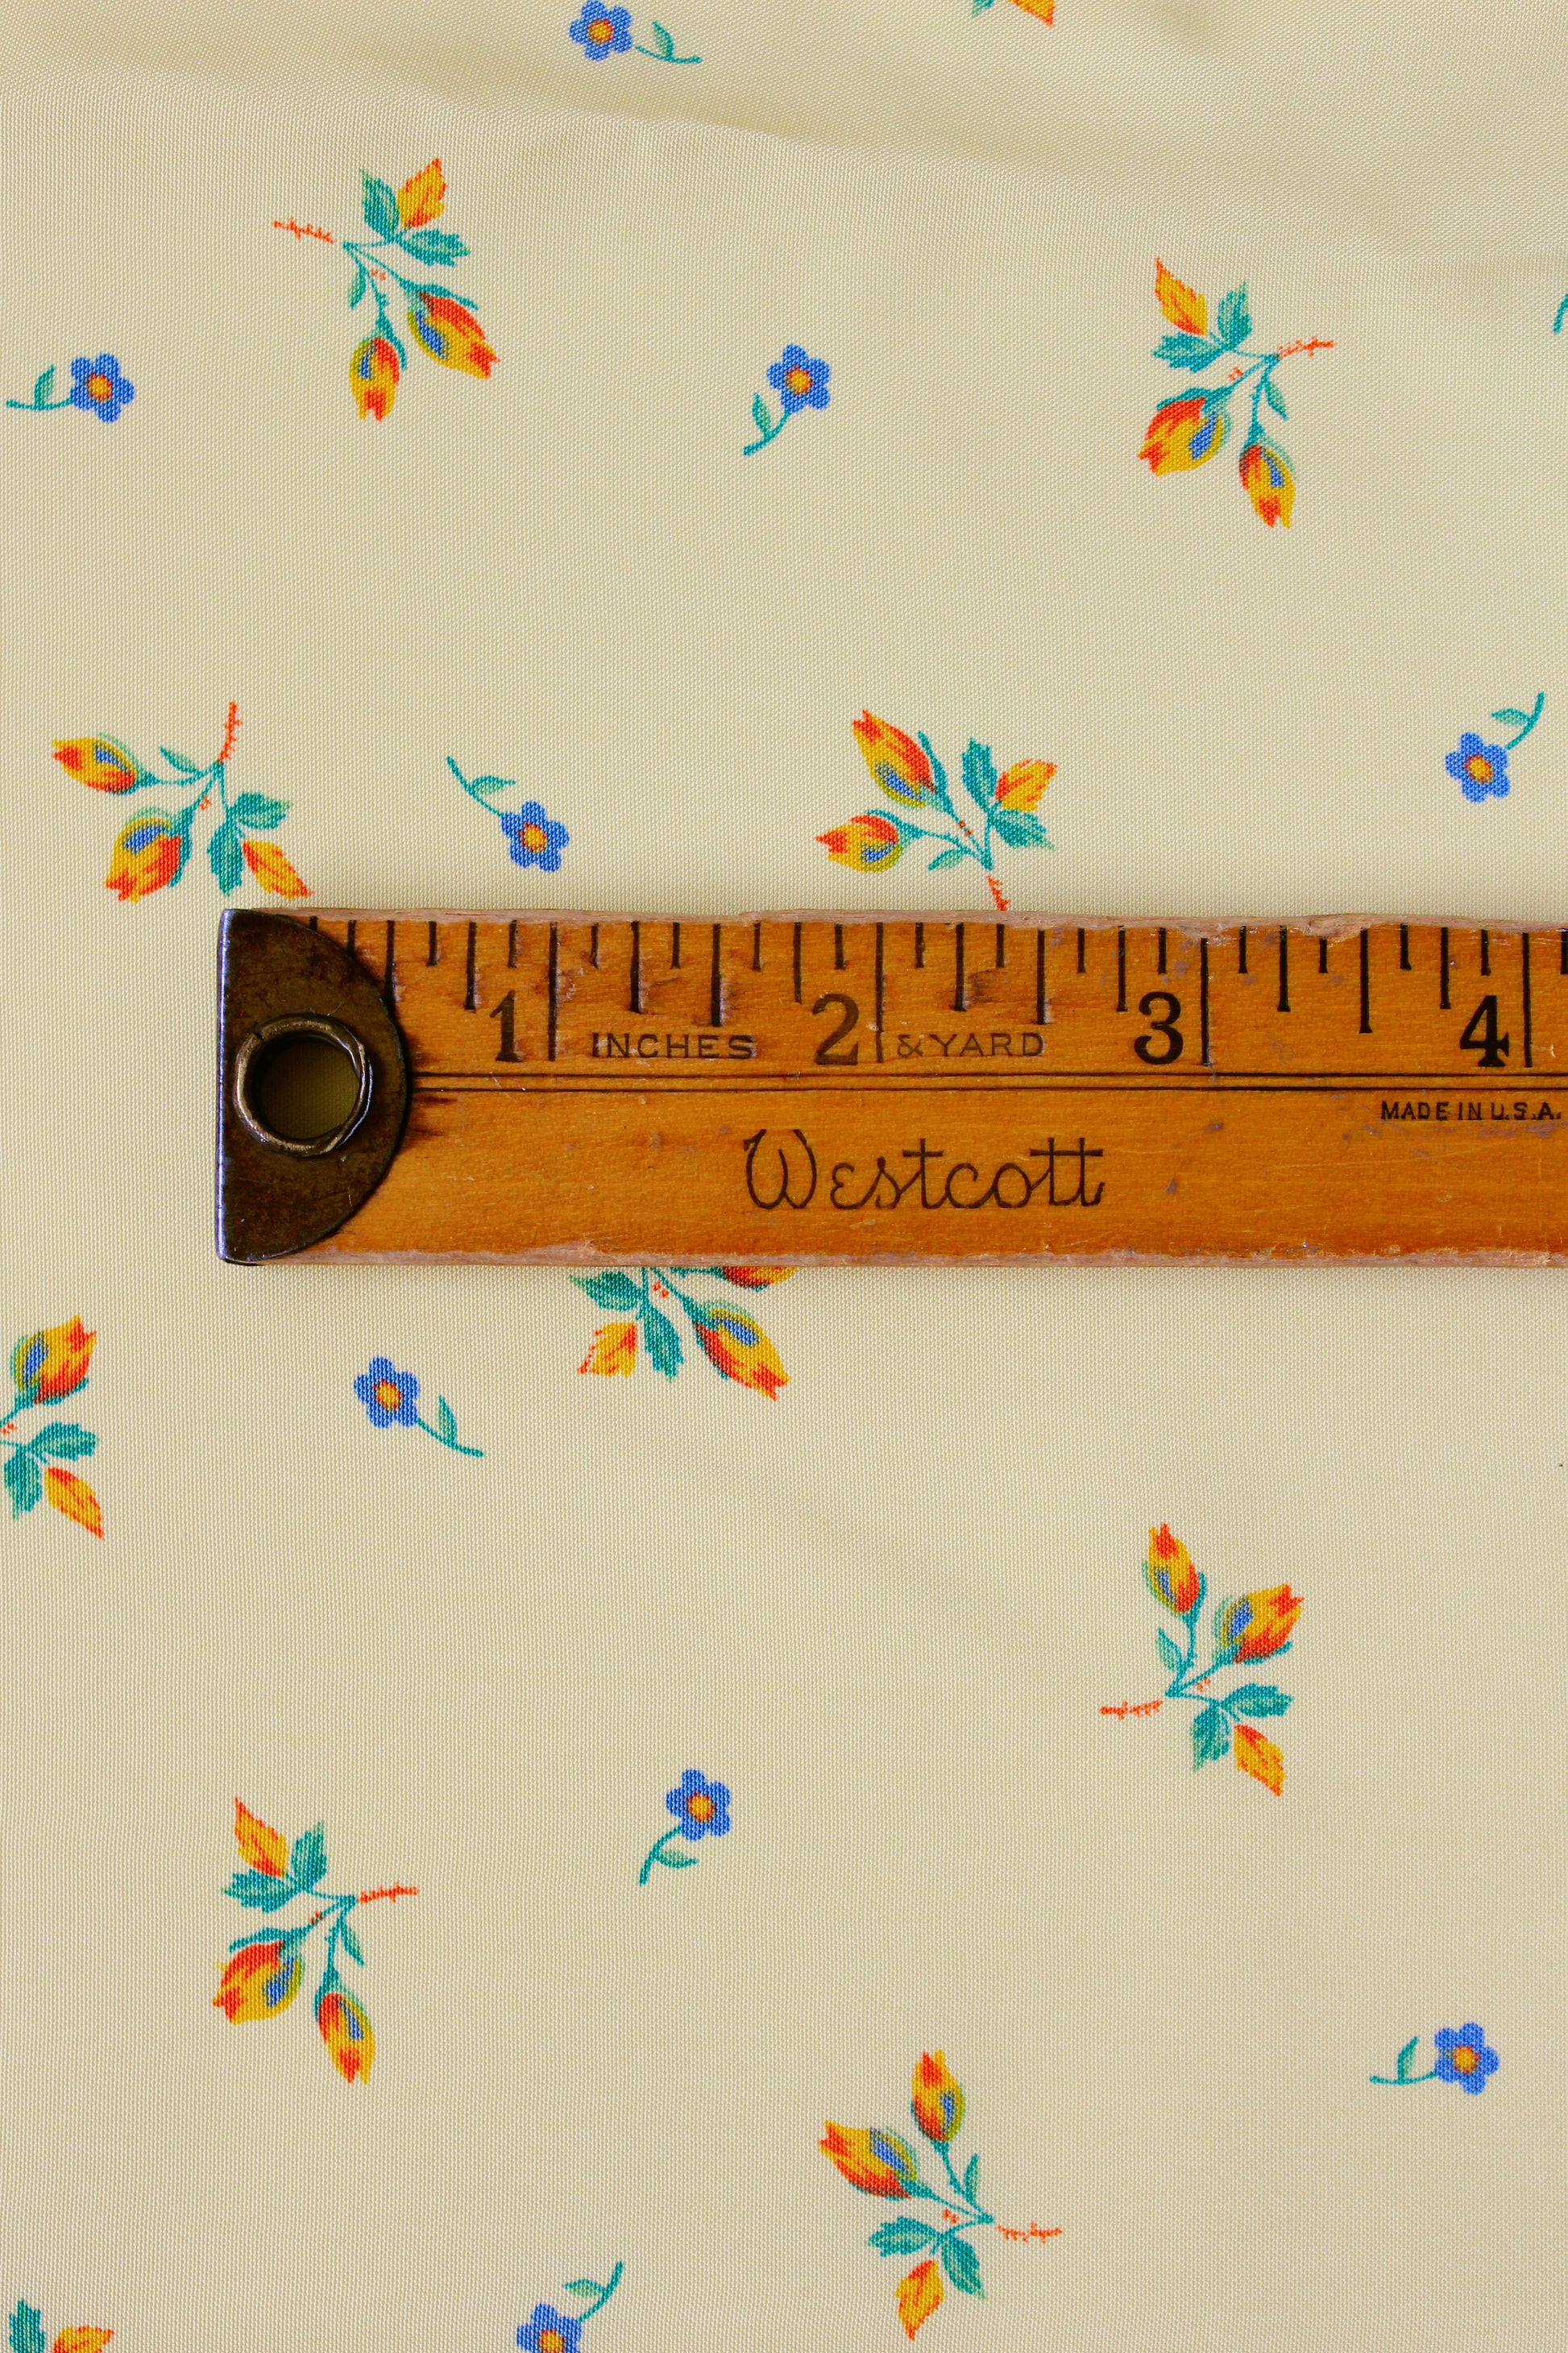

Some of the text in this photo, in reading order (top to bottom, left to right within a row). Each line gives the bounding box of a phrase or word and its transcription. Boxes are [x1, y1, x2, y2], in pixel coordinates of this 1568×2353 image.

[490, 990, 521, 1062] 1
[592, 1032, 757, 1059] INCHES
[930, 1032, 1044, 1057] YARD
[812, 993, 860, 1065] 2
[1134, 991, 1184, 1064] 3
[1459, 995, 1510, 1067] 4
[1381, 1100, 1562, 1121] MADE IN U.S.A.
[743, 1128, 1106, 1210] Westcott
